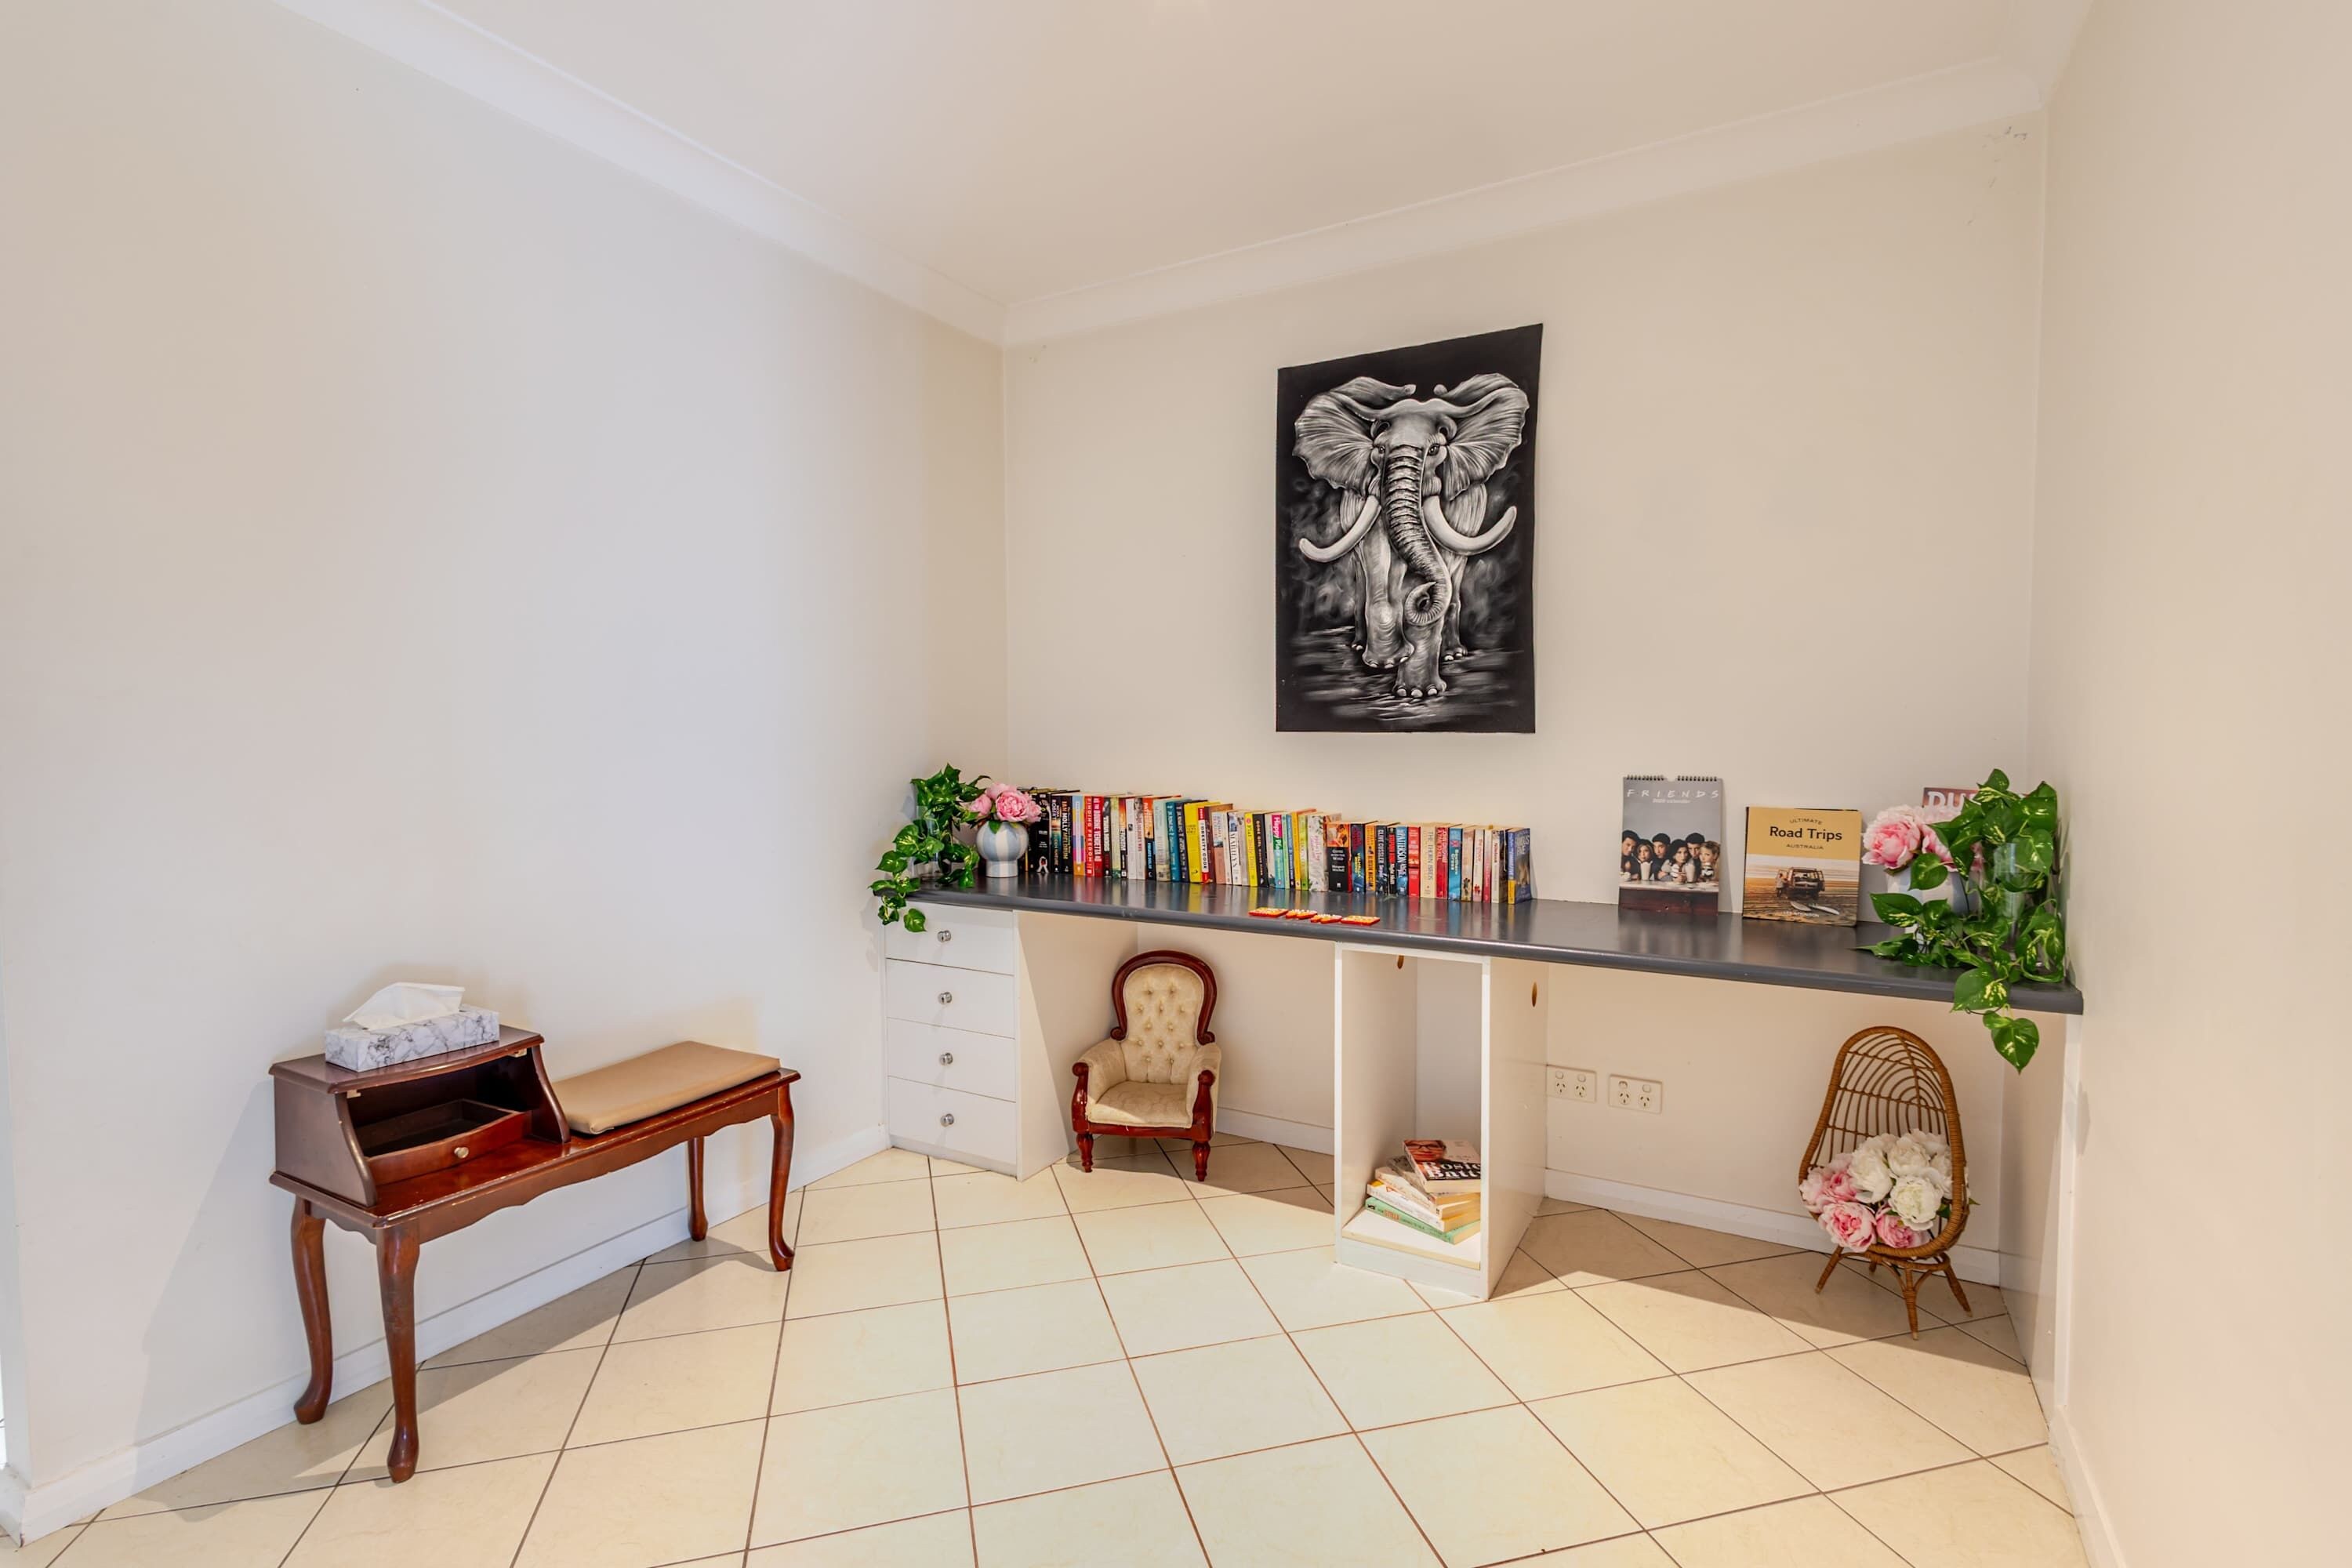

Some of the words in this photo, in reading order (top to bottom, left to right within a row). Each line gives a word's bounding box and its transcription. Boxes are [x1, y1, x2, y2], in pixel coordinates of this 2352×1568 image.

[1272, 816, 1281, 839] Happy
[1769, 826, 1803, 838] Road
[1807, 829, 1843, 843] Trips
[1396, 833, 1406, 863] PATTERSON
